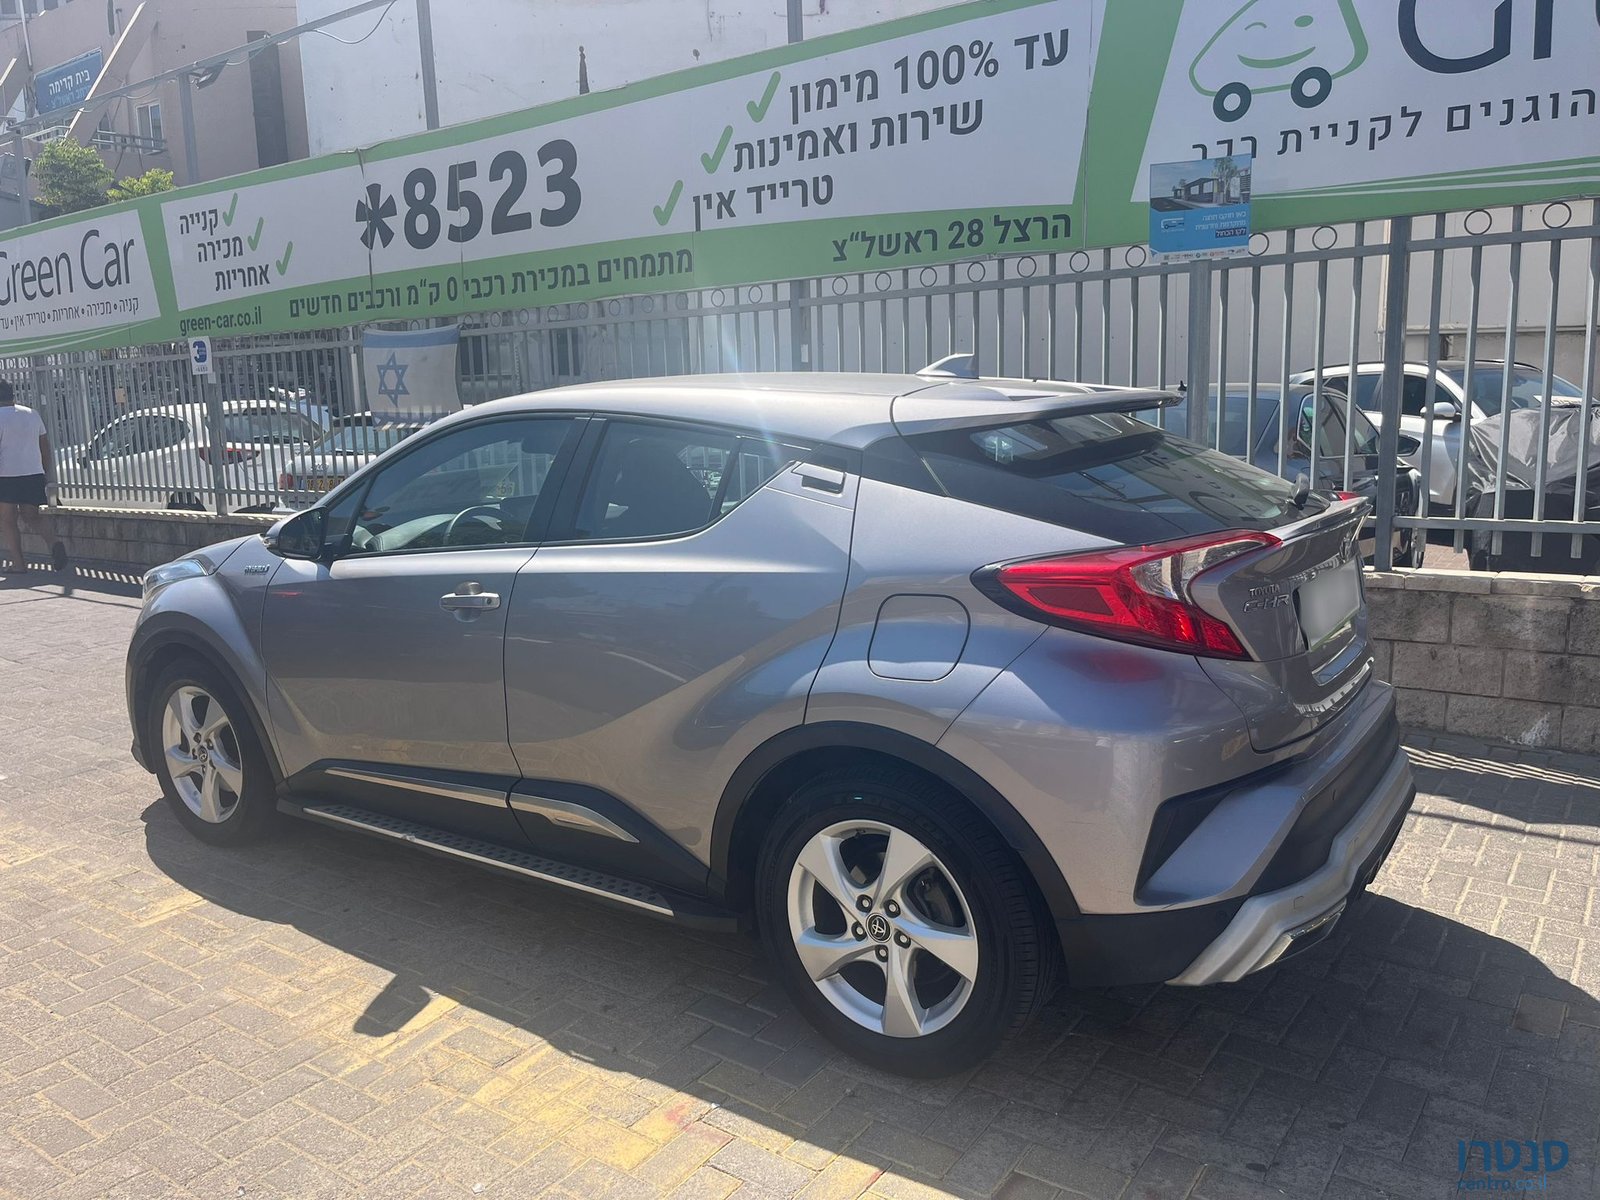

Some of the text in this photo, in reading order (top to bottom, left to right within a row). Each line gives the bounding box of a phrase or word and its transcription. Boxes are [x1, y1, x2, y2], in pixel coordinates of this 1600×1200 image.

[75, 69, 91, 85] בית
[790, 28, 1069, 125] עד 100% מימון
[1447, 88, 1596, 133] הוגנים
[734, 98, 983, 173] שירות ואמינות
[1278, 105, 1423, 156] לקניית
[693, 174, 834, 233] טרייד אין
[180, 208, 218, 235] קנייה
[948, 218, 984, 250] 28
[993, 212, 1072, 246] הרצל
[81, 229, 135, 290] Car
[198, 236, 244, 262] מכירה
[215, 263, 271, 292] אחריות
[511, 263, 590, 296] במכירת
[598, 247, 694, 284] מתמחים
[348, 287, 401, 314] ורכבים
[447, 276, 458, 302] 0
[463, 274, 505, 302] רכבי
[26, 311, 46, 326] טרייד
[52, 305, 81, 322] אחריות
[86, 301, 112, 317] מכירה
[119, 297, 139, 316] קניה
[290, 295, 343, 318] חדשים
[14, 314, 25, 332] אין
[179, 305, 262, 337] green-car.co.il
[1249, 585, 1280, 597] TOYOTA
